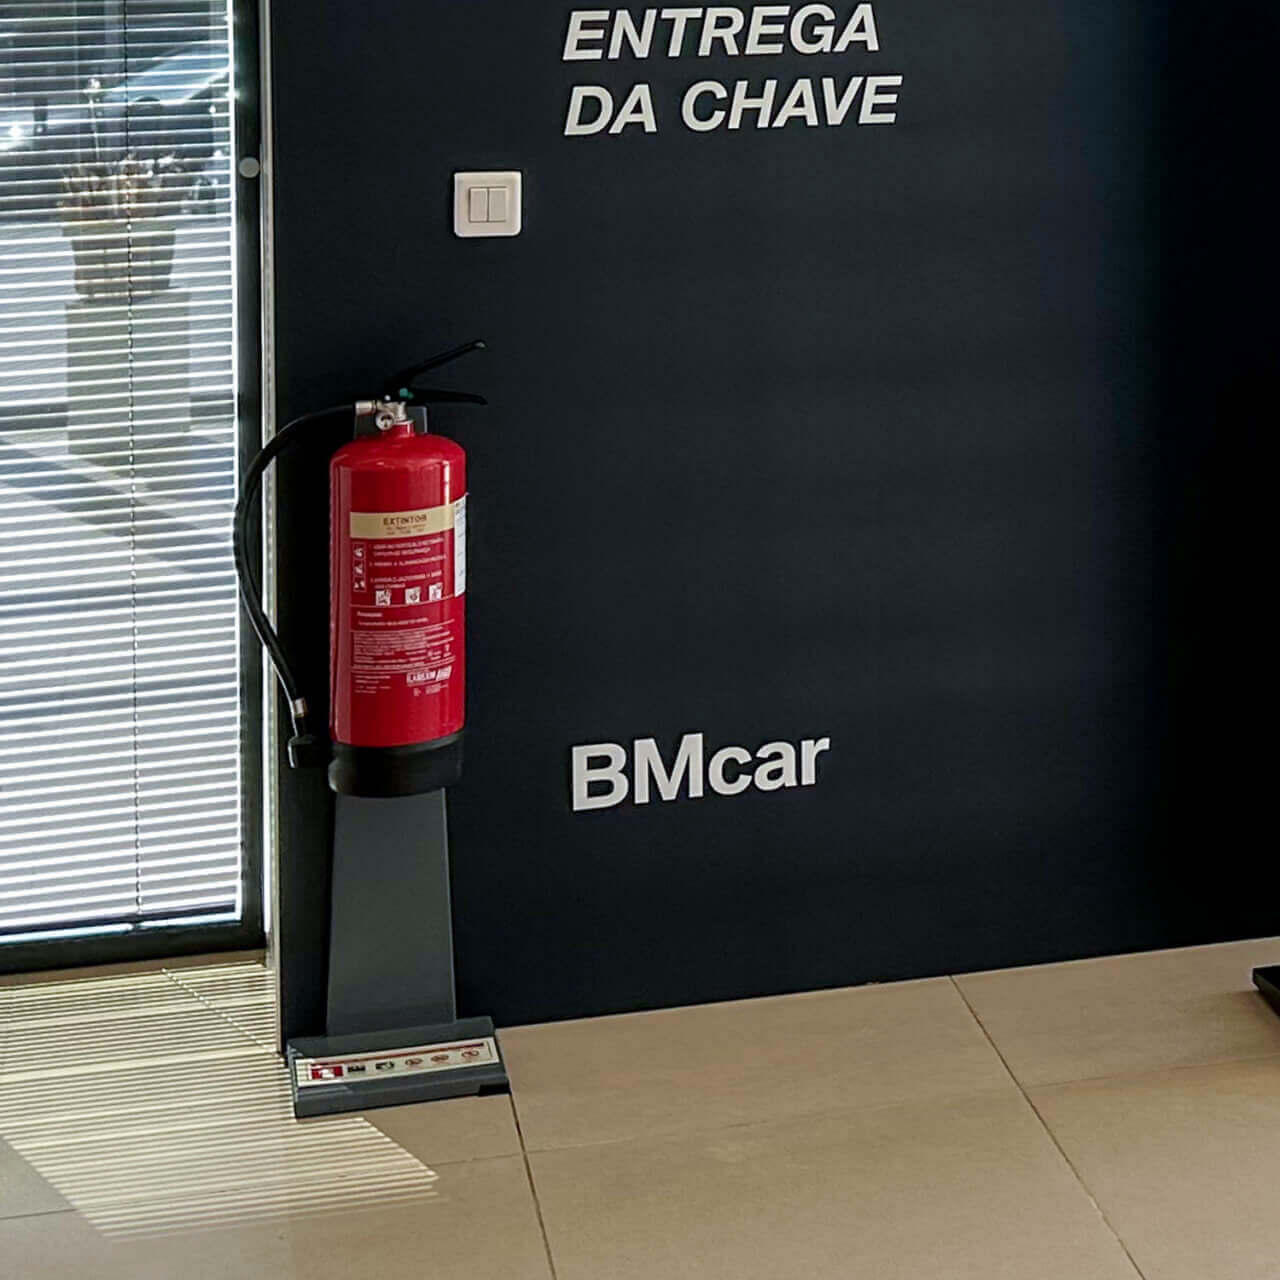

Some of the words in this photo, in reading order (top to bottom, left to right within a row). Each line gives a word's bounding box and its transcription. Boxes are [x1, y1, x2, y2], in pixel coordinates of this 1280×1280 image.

[562, 3, 880, 61] ENTREGA
[564, 84, 657, 136] DA
[681, 75, 903, 131] CHAVE
[572, 732, 831, 812] BMcar
